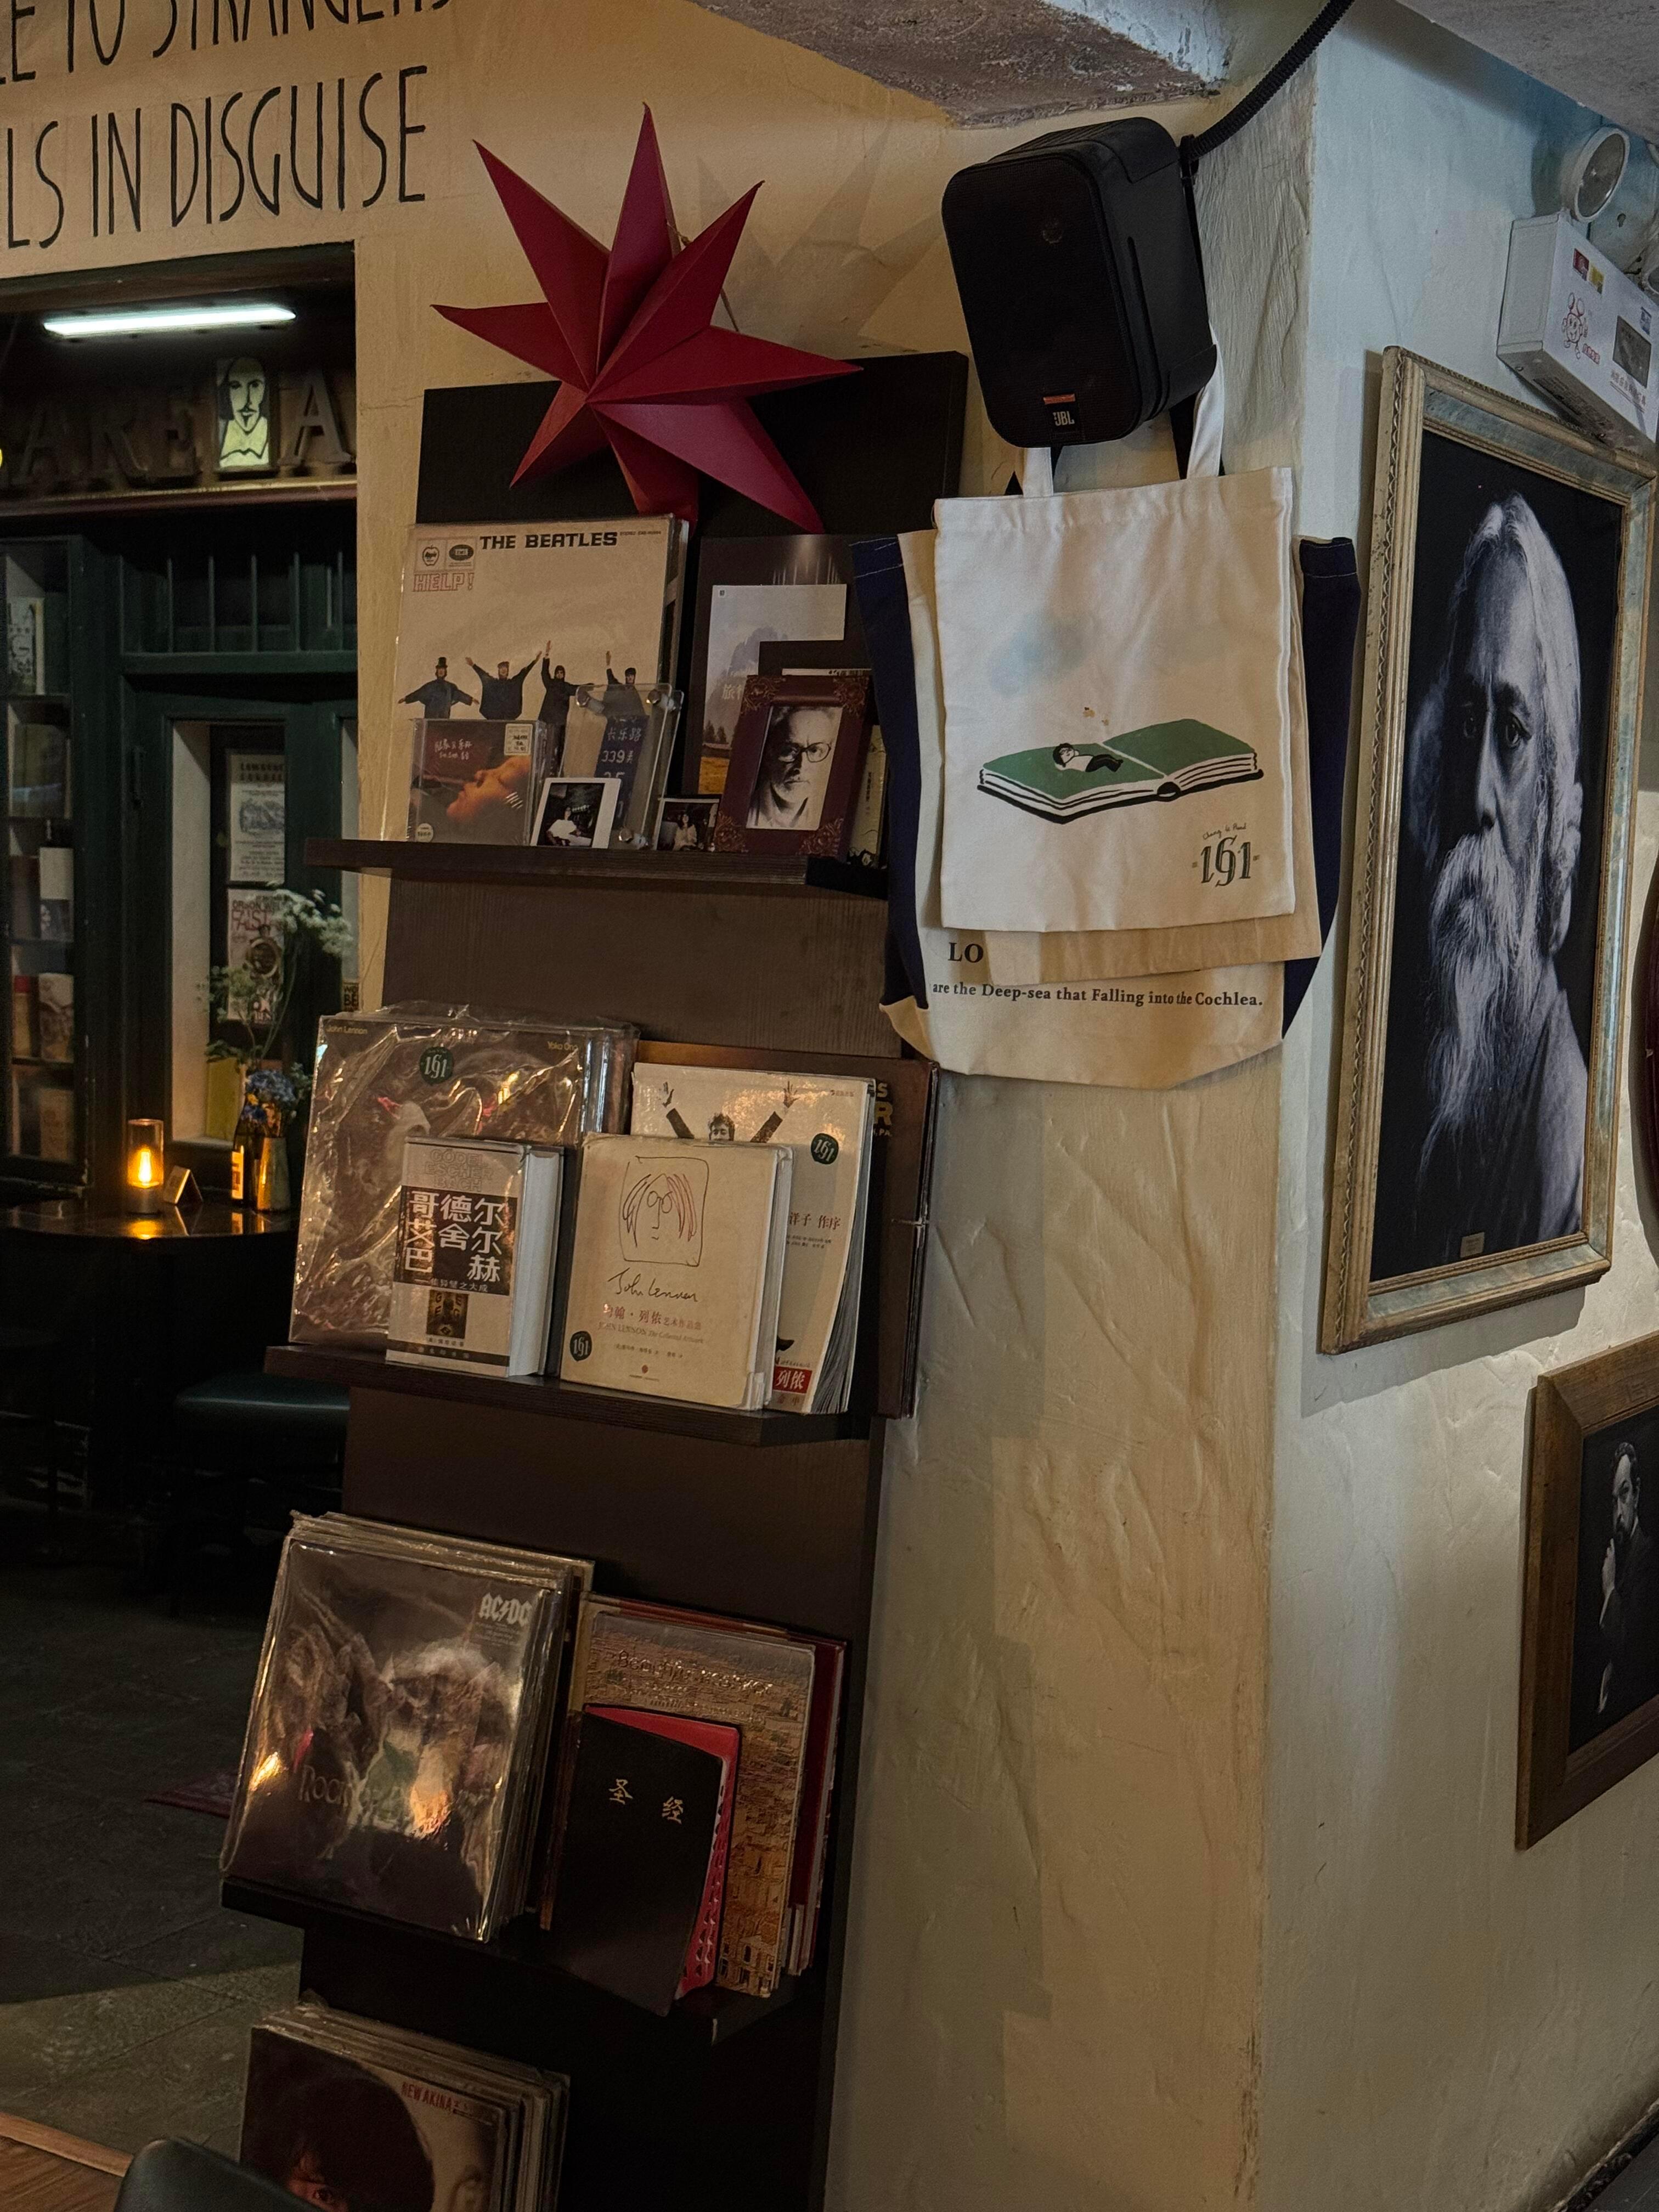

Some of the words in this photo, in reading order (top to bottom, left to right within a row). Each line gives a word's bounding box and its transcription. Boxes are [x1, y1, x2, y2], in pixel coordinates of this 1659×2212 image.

[7, 121, 64, 249] LS
[92, 108, 142, 237] IN
[171, 65, 427, 227] DISGUISE
[1052, 411, 1075, 426] JBL
[479, 535, 516, 550] THE
[525, 532, 618, 548] BEATLES
[413, 572, 475, 592] HELP!
[607, 727, 642, 742] 长乐路
[1200, 834, 1251, 888] 161
[948, 942, 984, 963] LO
[933, 983, 950, 994] are
[953, 981, 977, 995] the
[981, 984, 1051, 1002] Deep-sea
[1056, 987, 1087, 1001] that
[1091, 988, 1144, 1007] Falling
[1148, 991, 1173, 1005] into
[1176, 991, 1193, 1005] the
[1195, 991, 1263, 1006] Cochlea.
[425, 1161, 494, 1180] ESCHER
[433, 1175, 482, 1192] BACH
[410, 1190, 507, 1228] 哥德尔
[818, 1215, 841, 1230] 作序
[405, 1218, 503, 1256] 艾舍尔
[607, 1267, 644, 1296] John
[478, 1592, 533, 1627] AC/DC
[608, 1778, 685, 1825] 圣经
